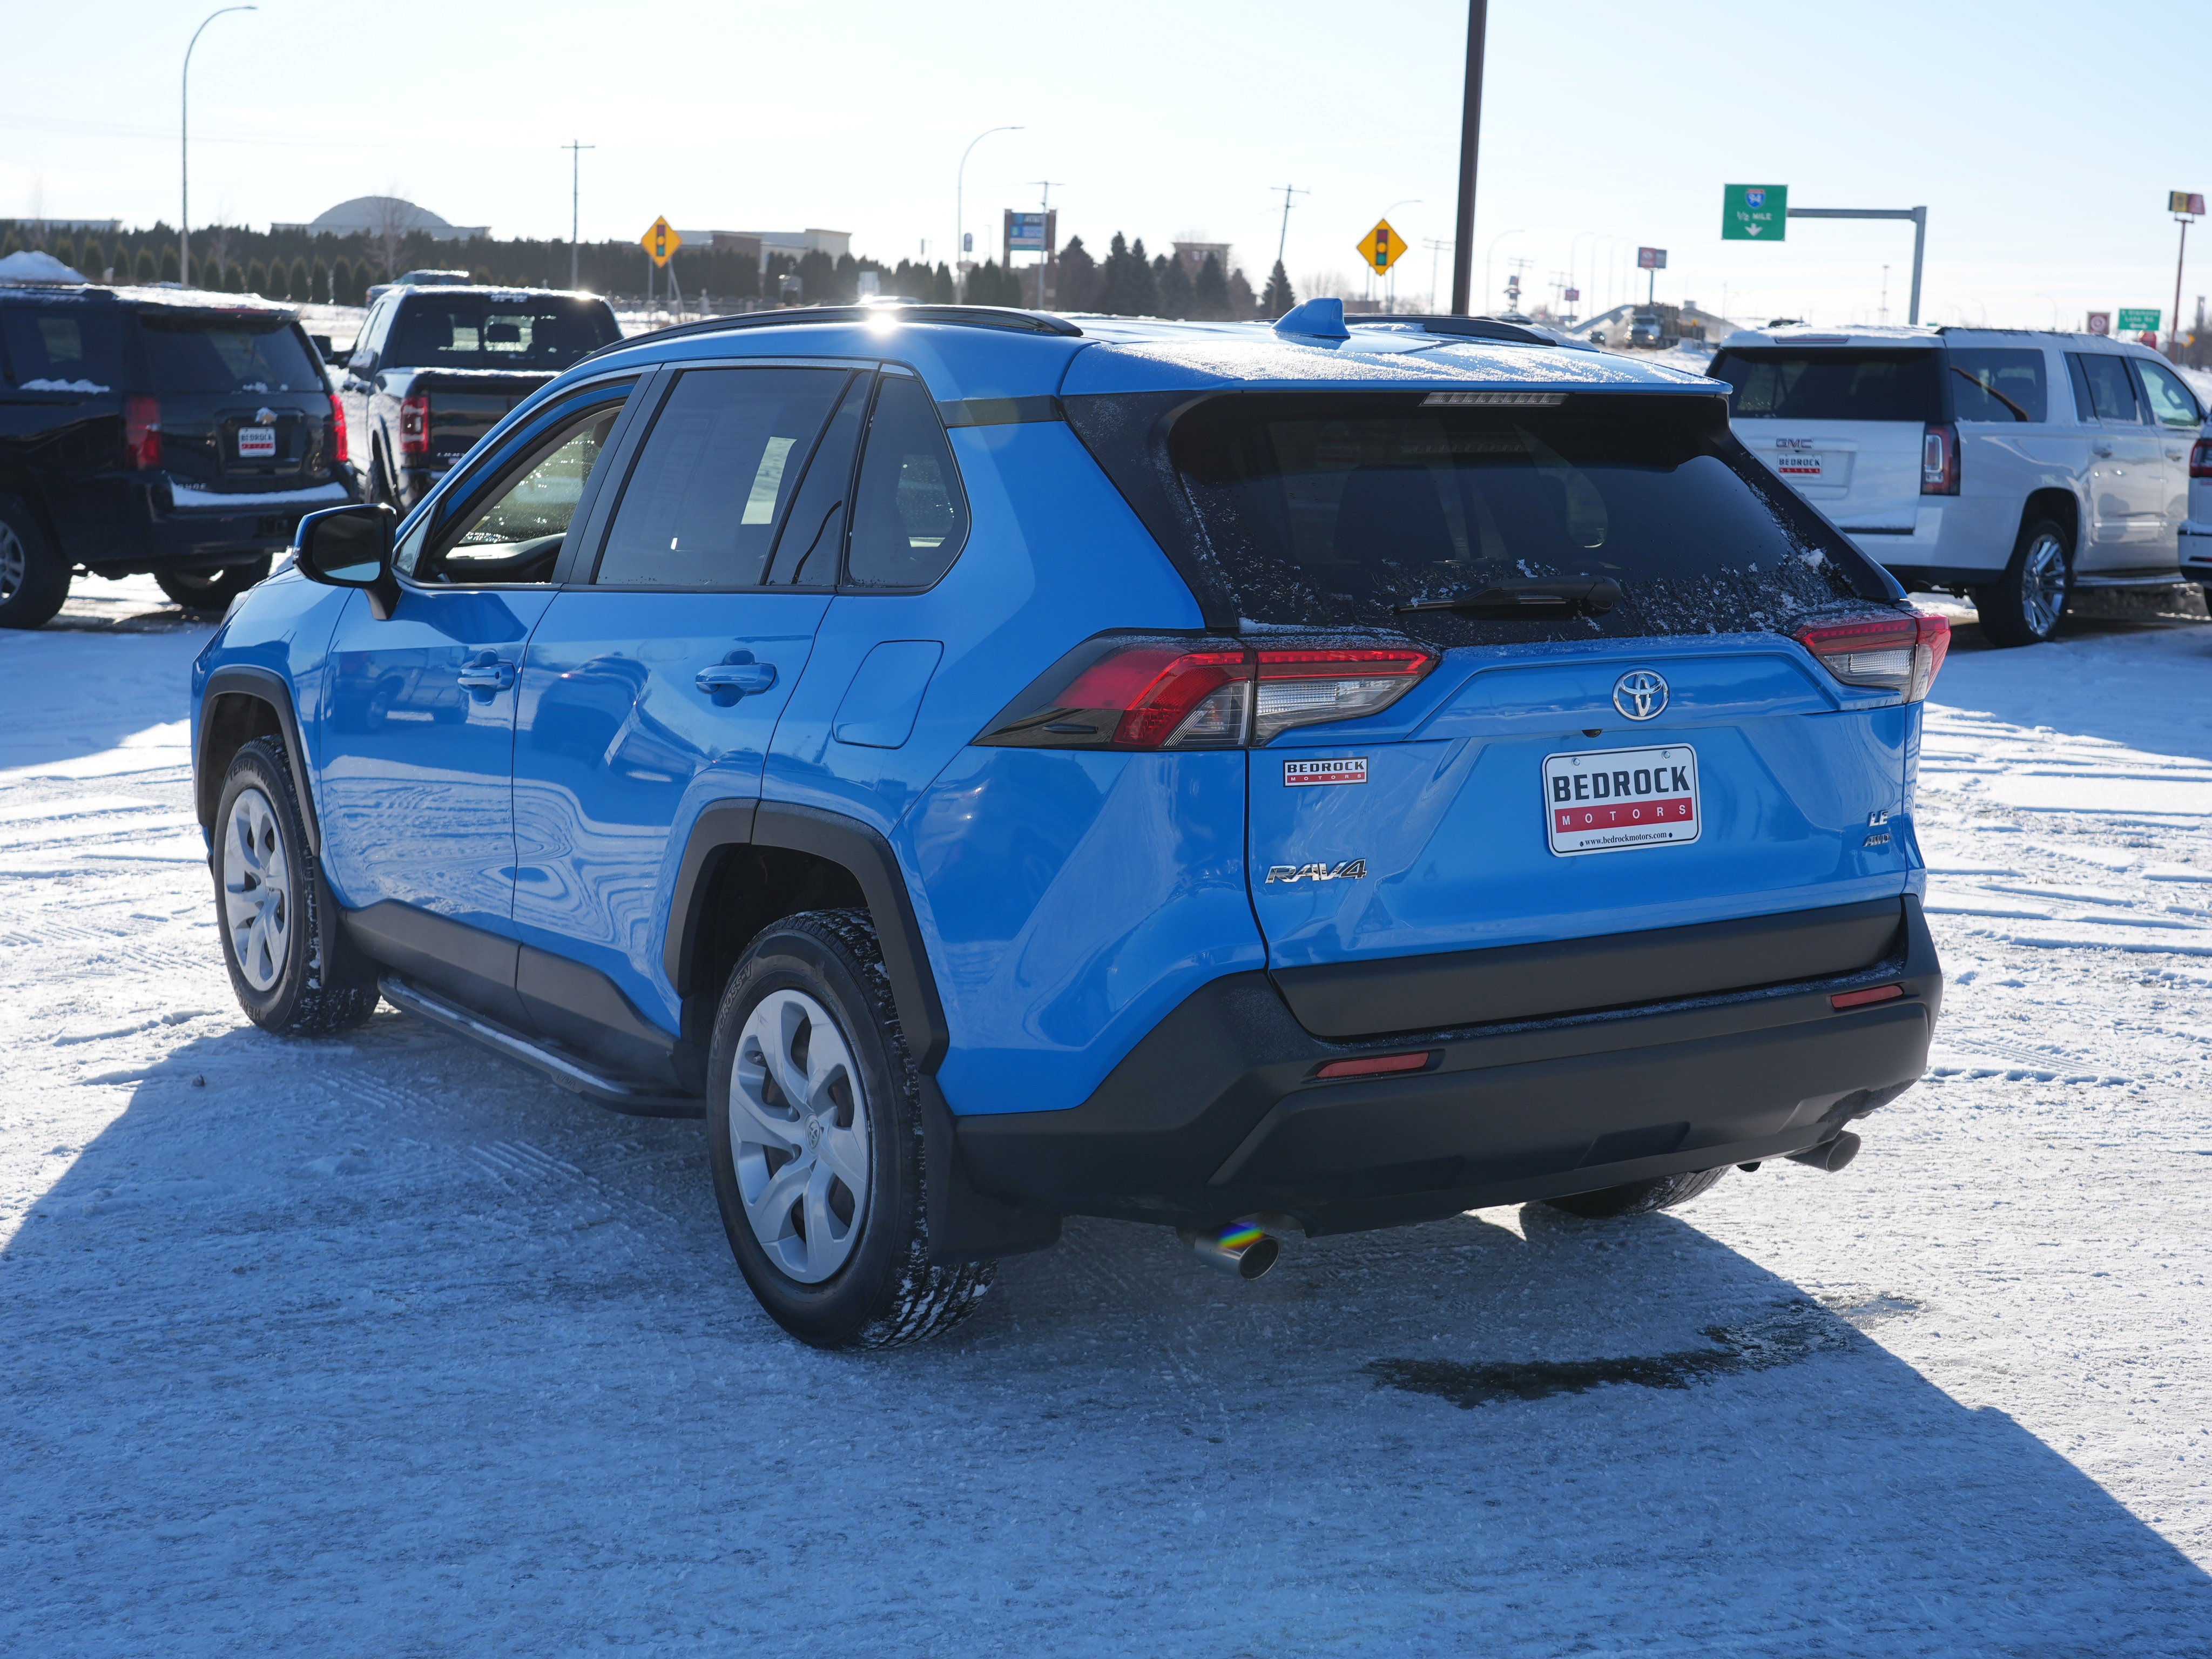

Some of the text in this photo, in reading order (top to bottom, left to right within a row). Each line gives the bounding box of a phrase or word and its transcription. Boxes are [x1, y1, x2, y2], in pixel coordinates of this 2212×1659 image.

[1776, 438, 1813, 448] GMC
[1779, 458, 1820, 466] BEDROCK
[1287, 761, 1365, 773] BEDROCK
[1552, 766, 1690, 802] BEDROCK
[1562, 804, 1686, 826] MOTORS
[1867, 810, 1889, 827] LE
[1585, 832, 1667, 846] www.bedrockmotors.com
[1863, 833, 1890, 847] AWD
[1265, 858, 1367, 884] RAV4
[718, 960, 752, 1030] CROSS-V
